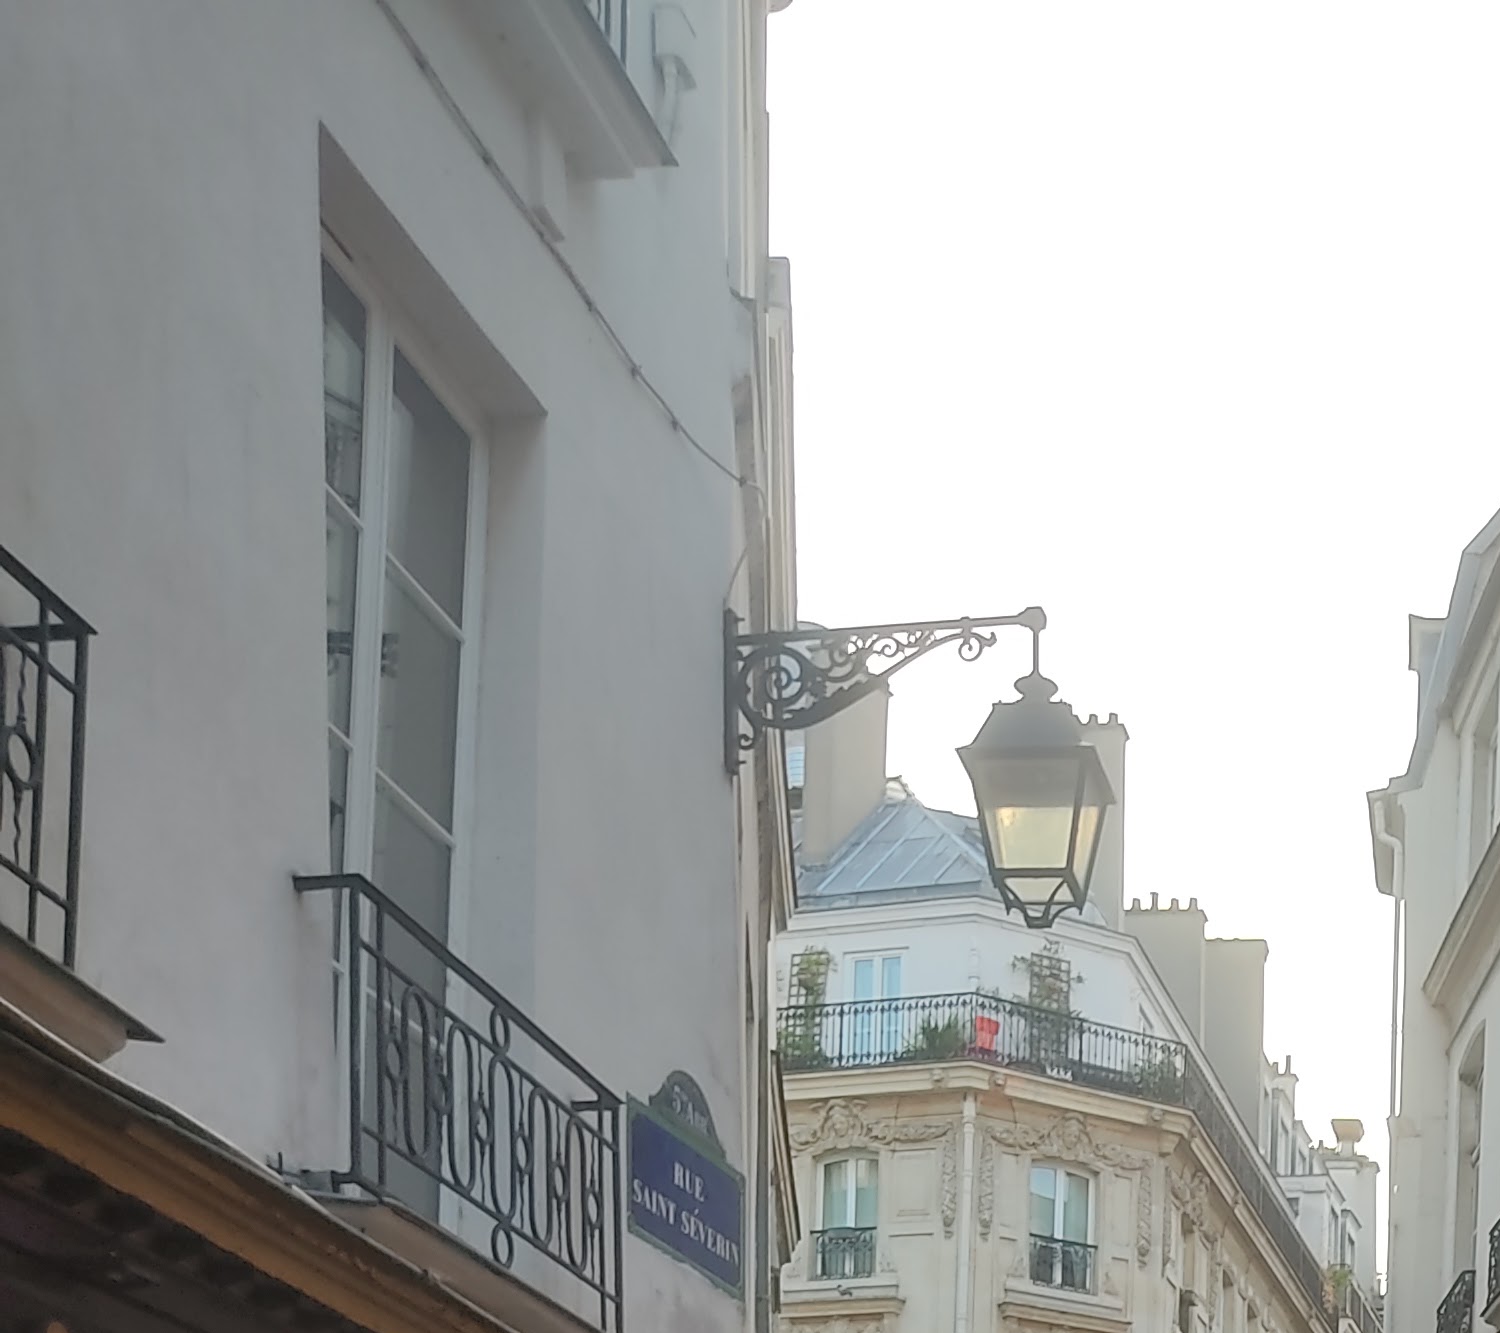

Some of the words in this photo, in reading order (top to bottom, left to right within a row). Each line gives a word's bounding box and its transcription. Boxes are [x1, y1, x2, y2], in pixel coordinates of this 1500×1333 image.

[673, 1160, 705, 1202] RUE
[632, 1178, 677, 1225] SAINT
[680, 1207, 740, 1266] SÉVERIN
